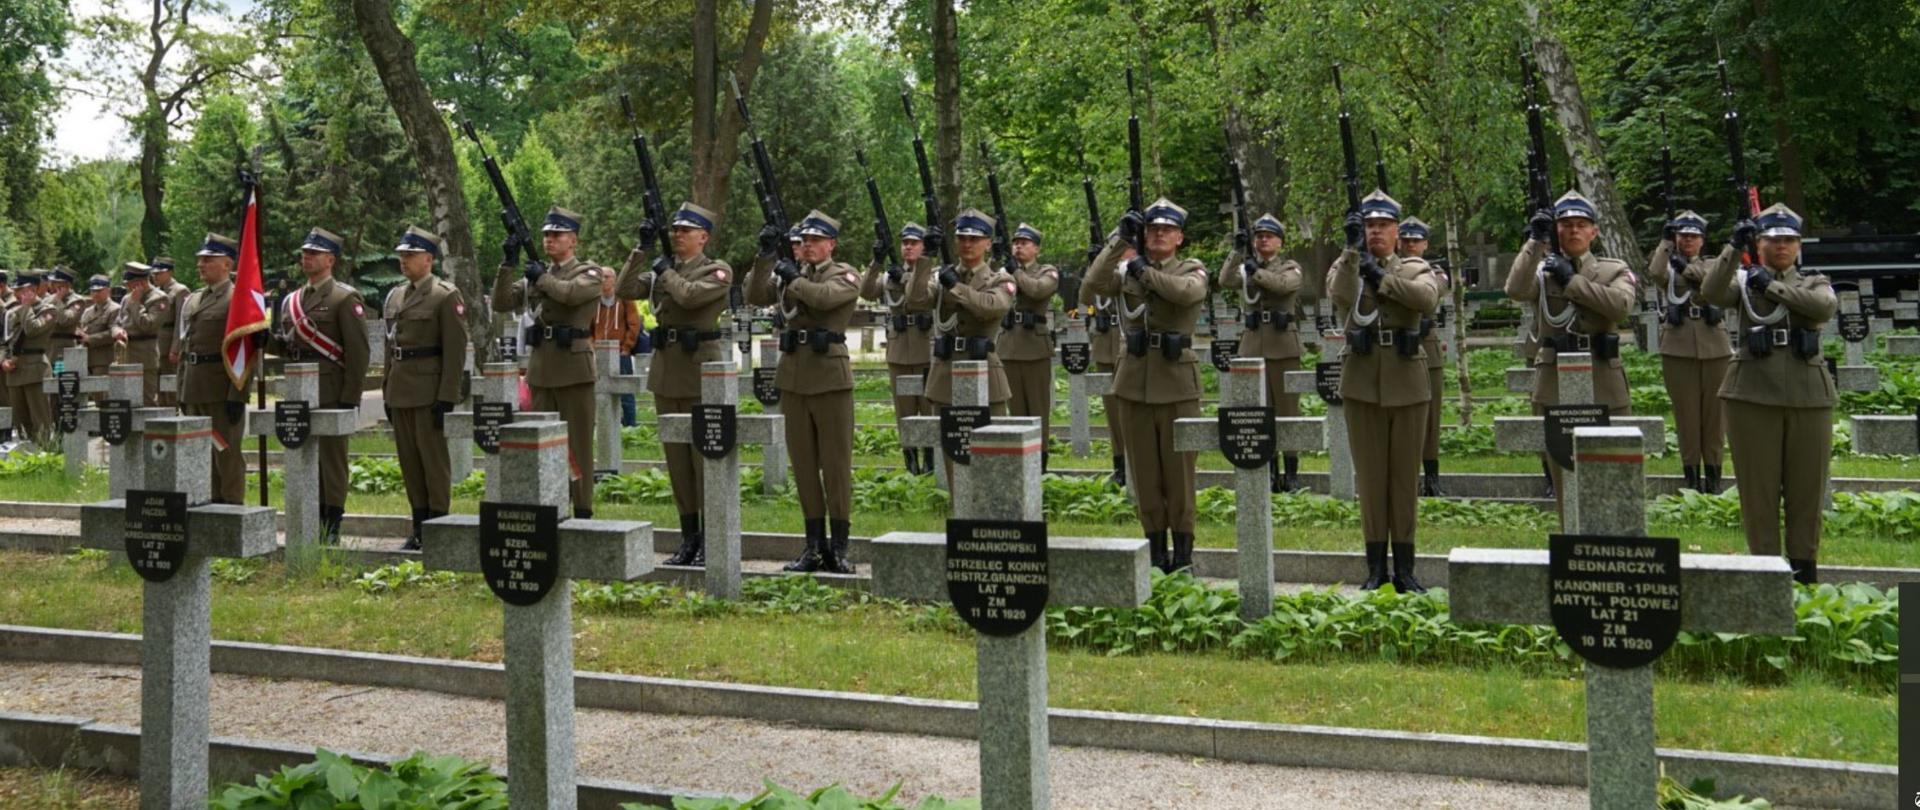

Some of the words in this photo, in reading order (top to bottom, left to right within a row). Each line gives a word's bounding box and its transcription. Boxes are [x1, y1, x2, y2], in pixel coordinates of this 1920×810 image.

[972, 528, 1021, 540] EDMUND
[505, 538, 530, 549] SZER.
[957, 541, 1037, 553] KONARKOWSKI
[1574, 544, 1656, 559] STANISŁAW
[502, 558, 518, 568] LAT
[947, 559, 1003, 571] STRZELEC
[1008, 561, 1047, 572] KONNY
[1568, 559, 1665, 574] BEDNARCZYK
[510, 570, 524, 580] ZM
[509, 580, 517, 590] IX
[520, 582, 540, 592] 1920
[978, 584, 998, 594] LAT
[1005, 585, 1016, 595] 19
[1554, 579, 1625, 594] KANONIER
[987, 597, 1006, 607] ZM
[1553, 593, 1602, 606] ARTYL.
[1610, 595, 1679, 610] POLOWEJ
[971, 607, 980, 617] 11
[987, 608, 998, 619] IX
[1002, 609, 1026, 620] 1920
[1591, 608, 1617, 620] LAT
[1623, 609, 1638, 621] 21
[1603, 623, 1627, 635] ZM
[1582, 635, 1595, 647] 10
[1602, 636, 1617, 648] IX
[1621, 638, 1653, 650] 1920
